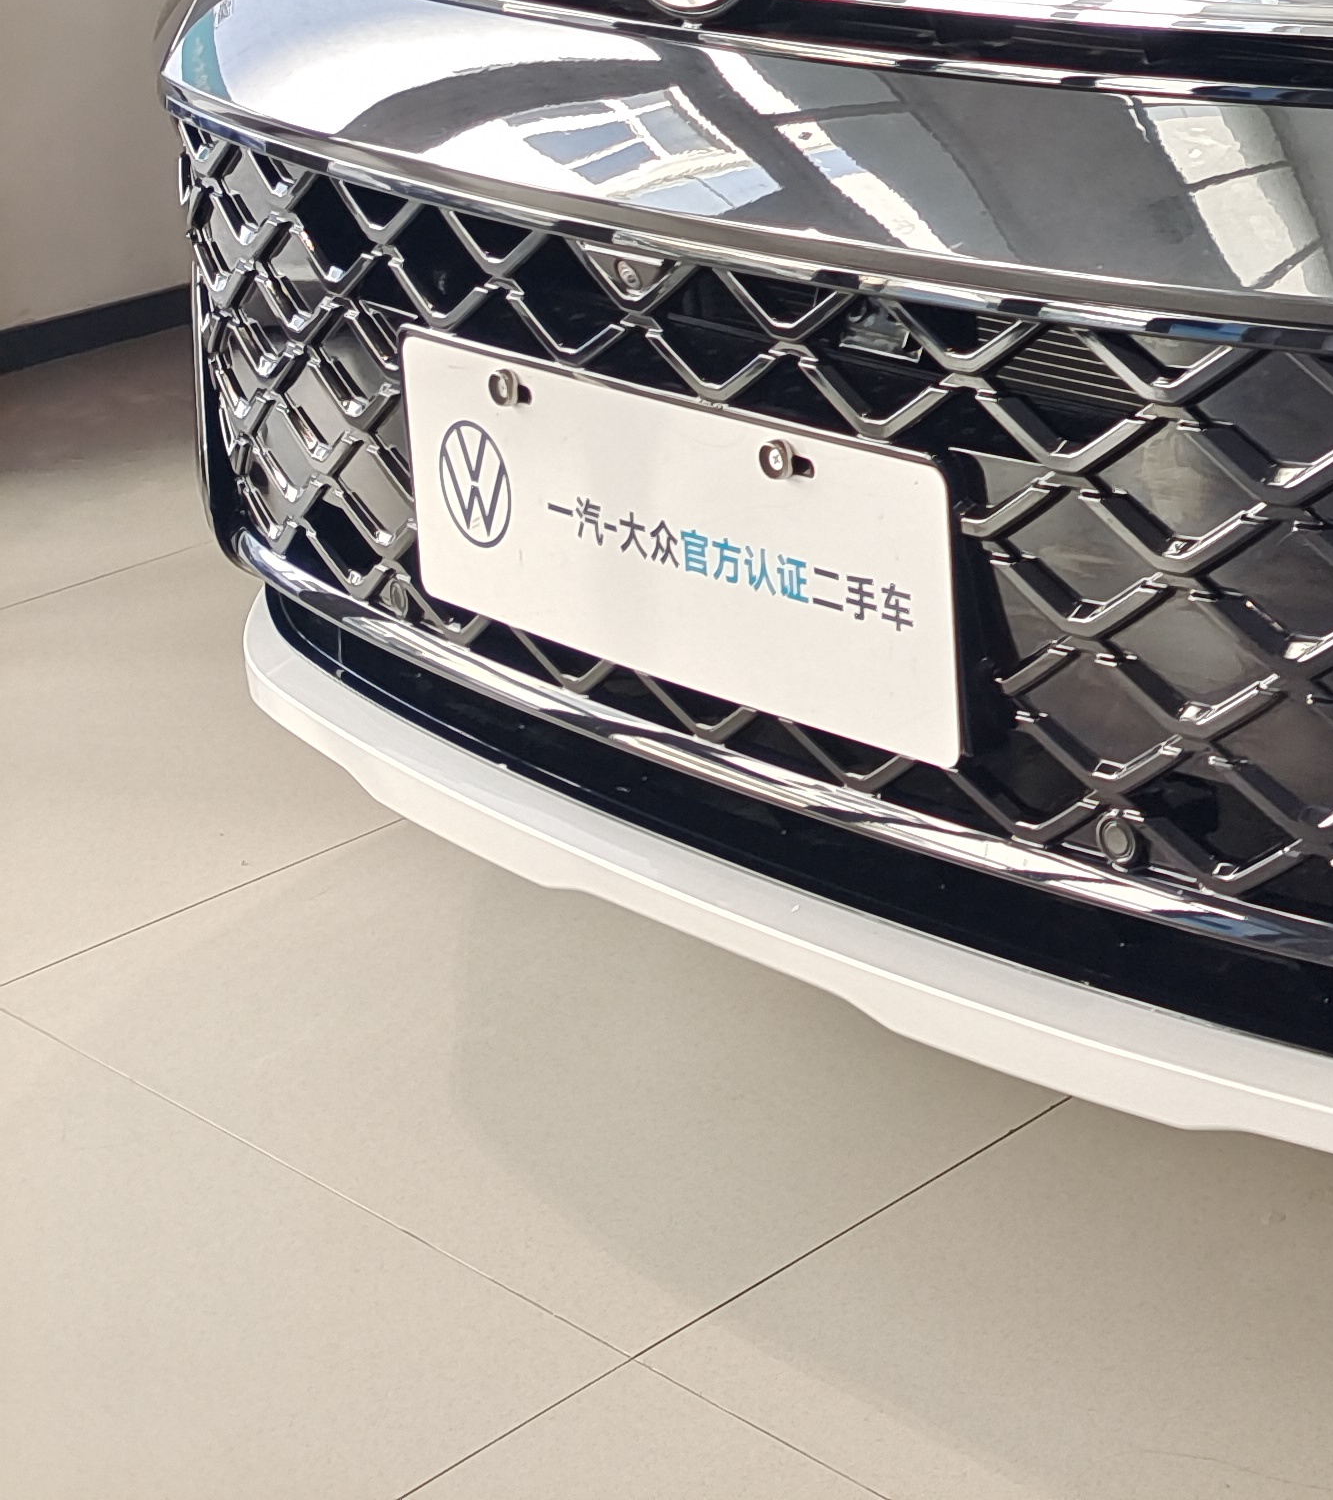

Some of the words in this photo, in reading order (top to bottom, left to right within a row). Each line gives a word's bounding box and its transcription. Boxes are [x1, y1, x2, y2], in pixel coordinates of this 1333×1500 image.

[439, 419, 511, 548] VW
[547, 496, 915, 632] 一汽-大众官方认证二手车
